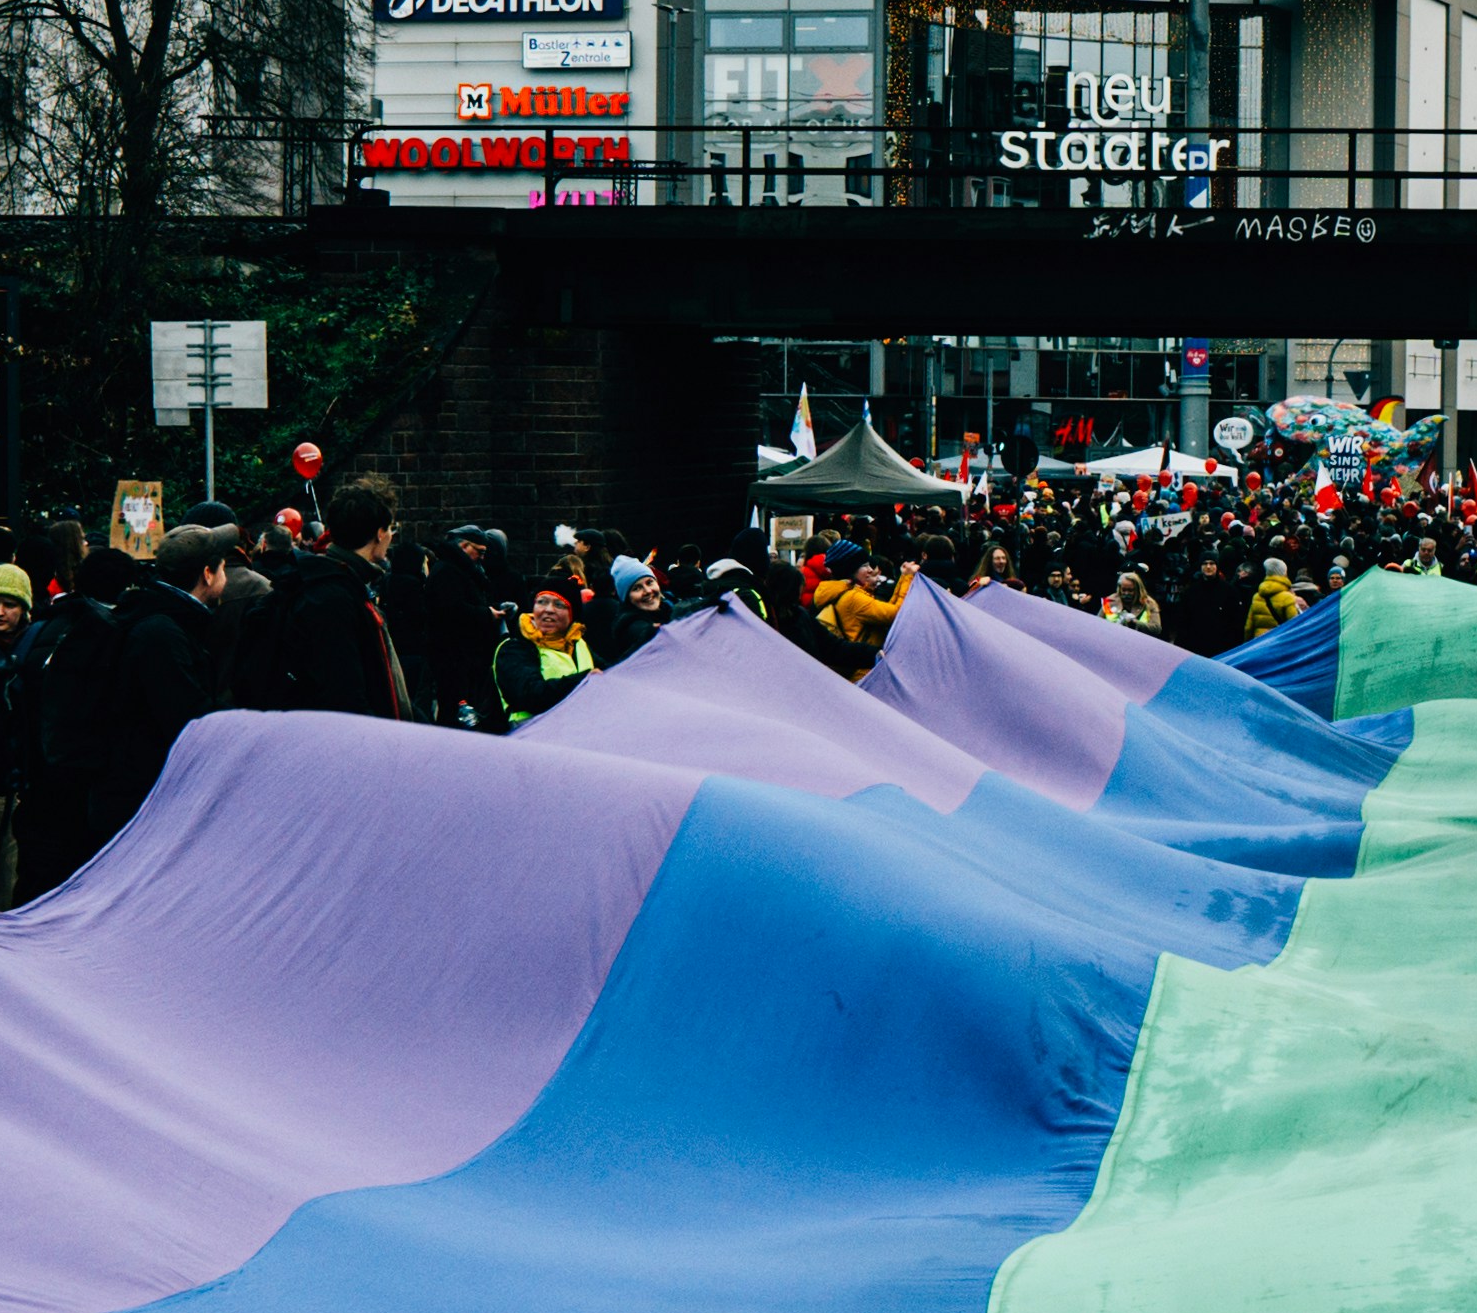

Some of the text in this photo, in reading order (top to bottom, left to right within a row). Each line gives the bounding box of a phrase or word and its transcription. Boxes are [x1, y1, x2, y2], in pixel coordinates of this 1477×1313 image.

[528, 37, 570, 50] Bastler
[560, 51, 611, 67] Zentrale
[498, 86, 630, 117] Müller
[1066, 70, 1172, 127] neu
[362, 136, 630, 168] WOOLWORTH
[999, 121, 1231, 181] städter
[1235, 213, 1352, 242] MASKE
[1328, 436, 1365, 454] WIR
[1329, 454, 1361, 467] SIND
[1327, 467, 1364, 484] MEHR
